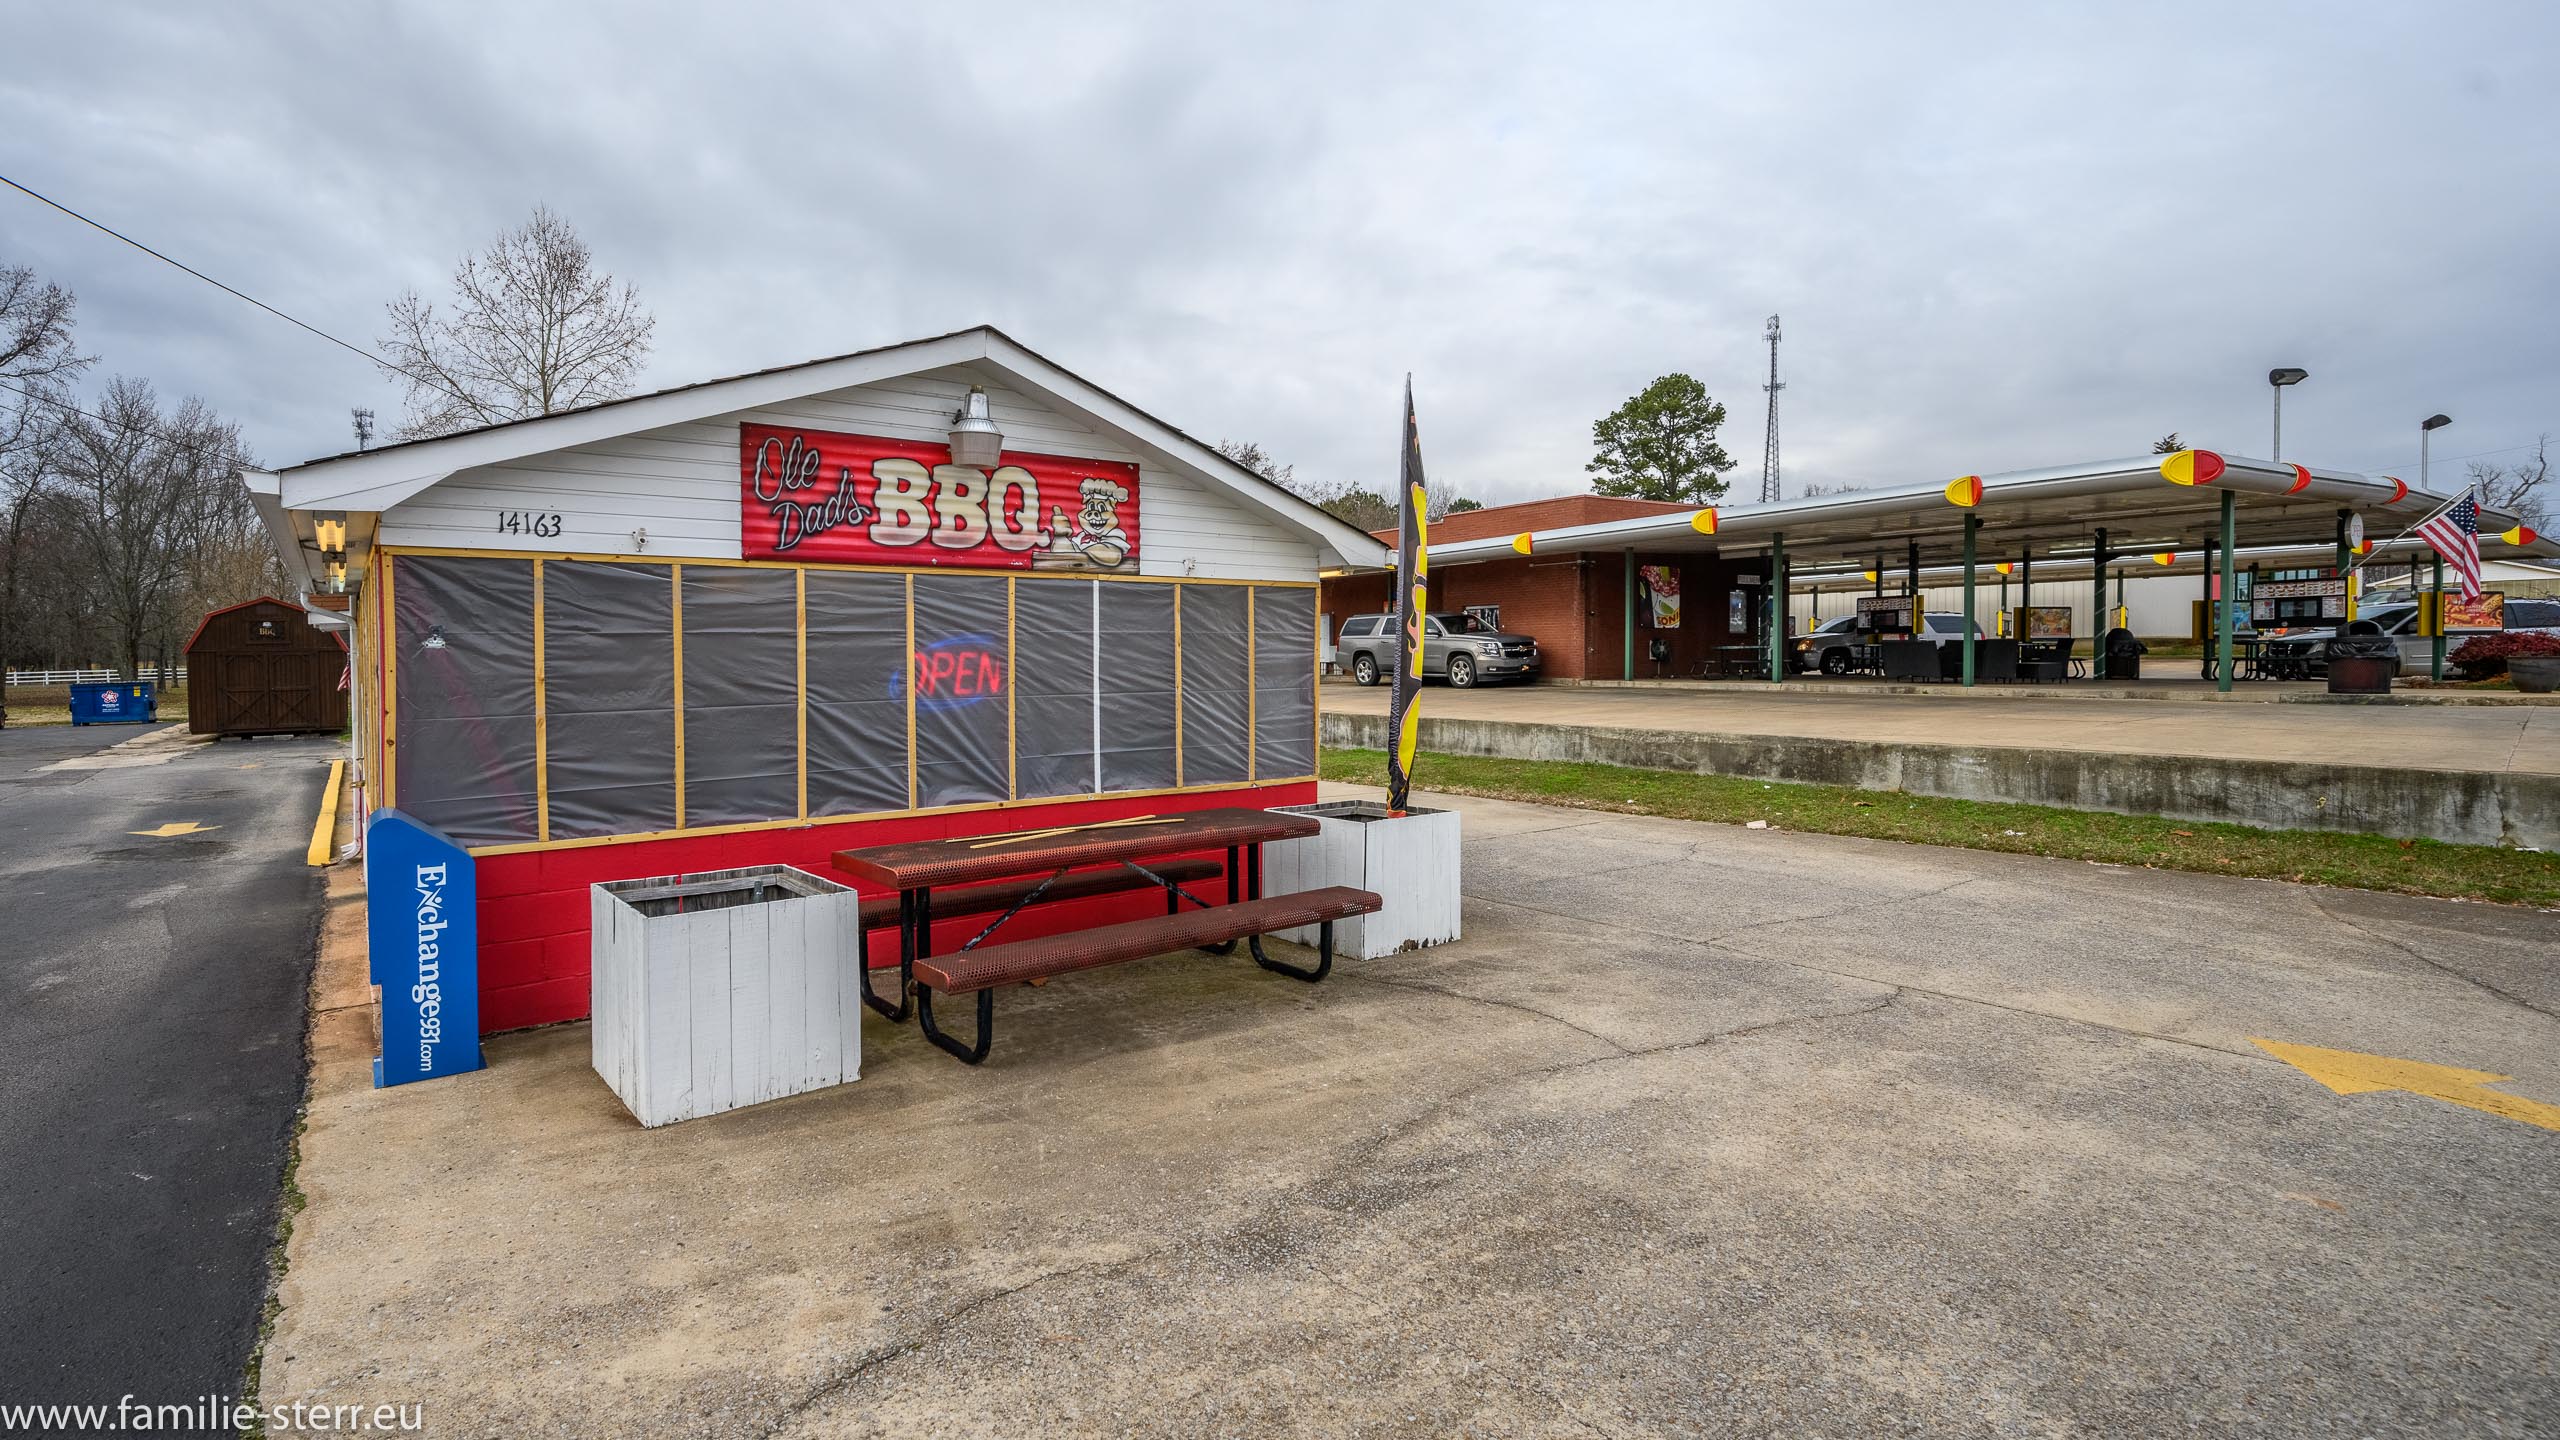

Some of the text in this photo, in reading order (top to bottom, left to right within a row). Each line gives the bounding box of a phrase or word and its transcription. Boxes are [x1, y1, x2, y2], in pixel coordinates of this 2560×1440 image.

[755, 436, 819, 502] Ole
[499, 511, 561, 537] 14163
[869, 458, 1051, 550] BBQ
